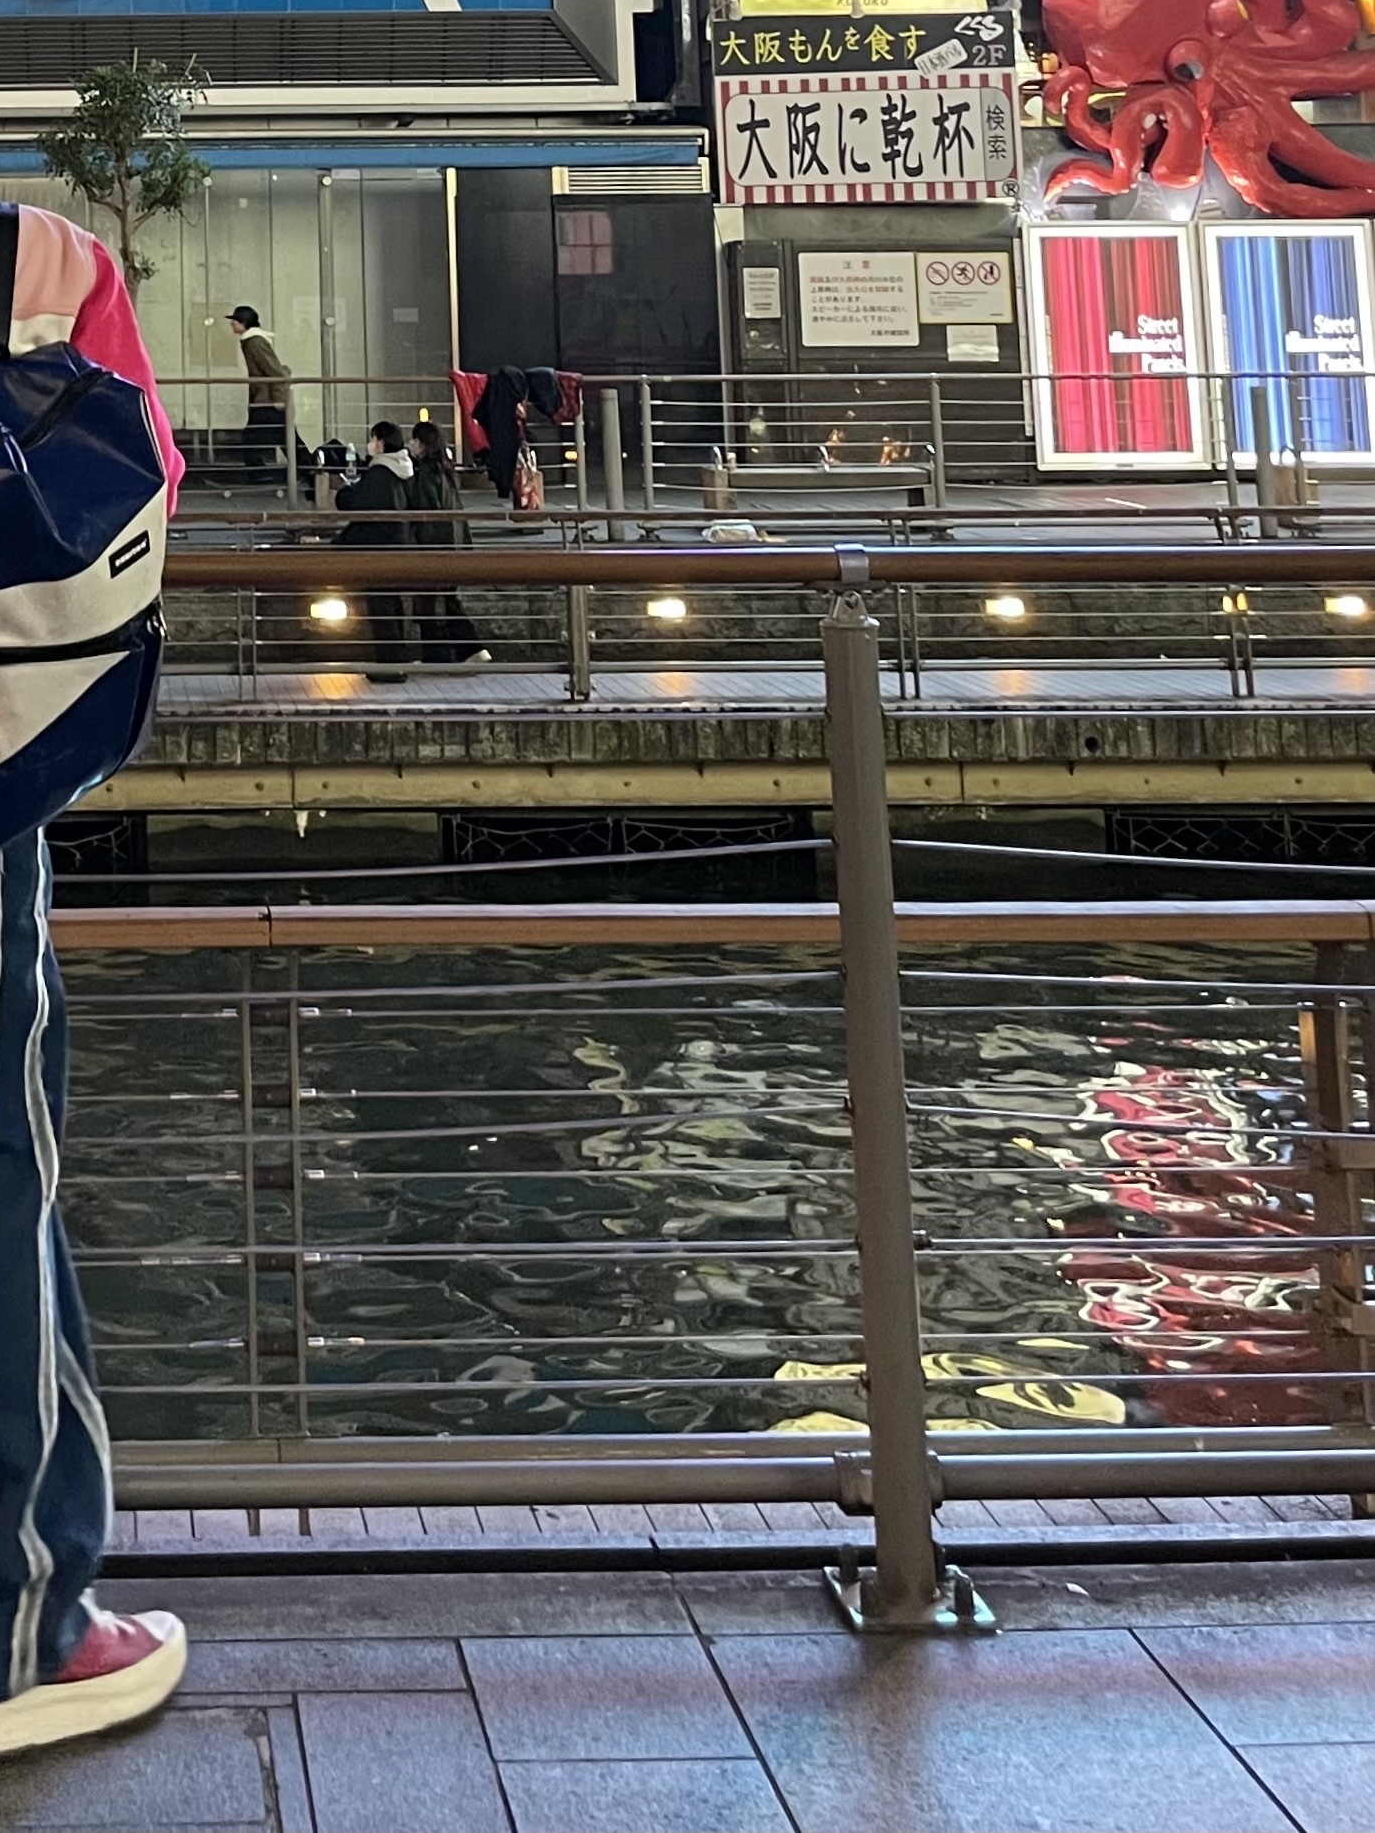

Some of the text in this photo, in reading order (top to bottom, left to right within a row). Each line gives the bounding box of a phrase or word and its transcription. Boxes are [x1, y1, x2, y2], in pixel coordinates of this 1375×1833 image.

[719, 24, 926, 65] 大阪もんを食す
[972, 44, 1006, 66] 2F
[736, 93, 974, 180] 大阪に乾杯
[986, 104, 1007, 160] 検索
